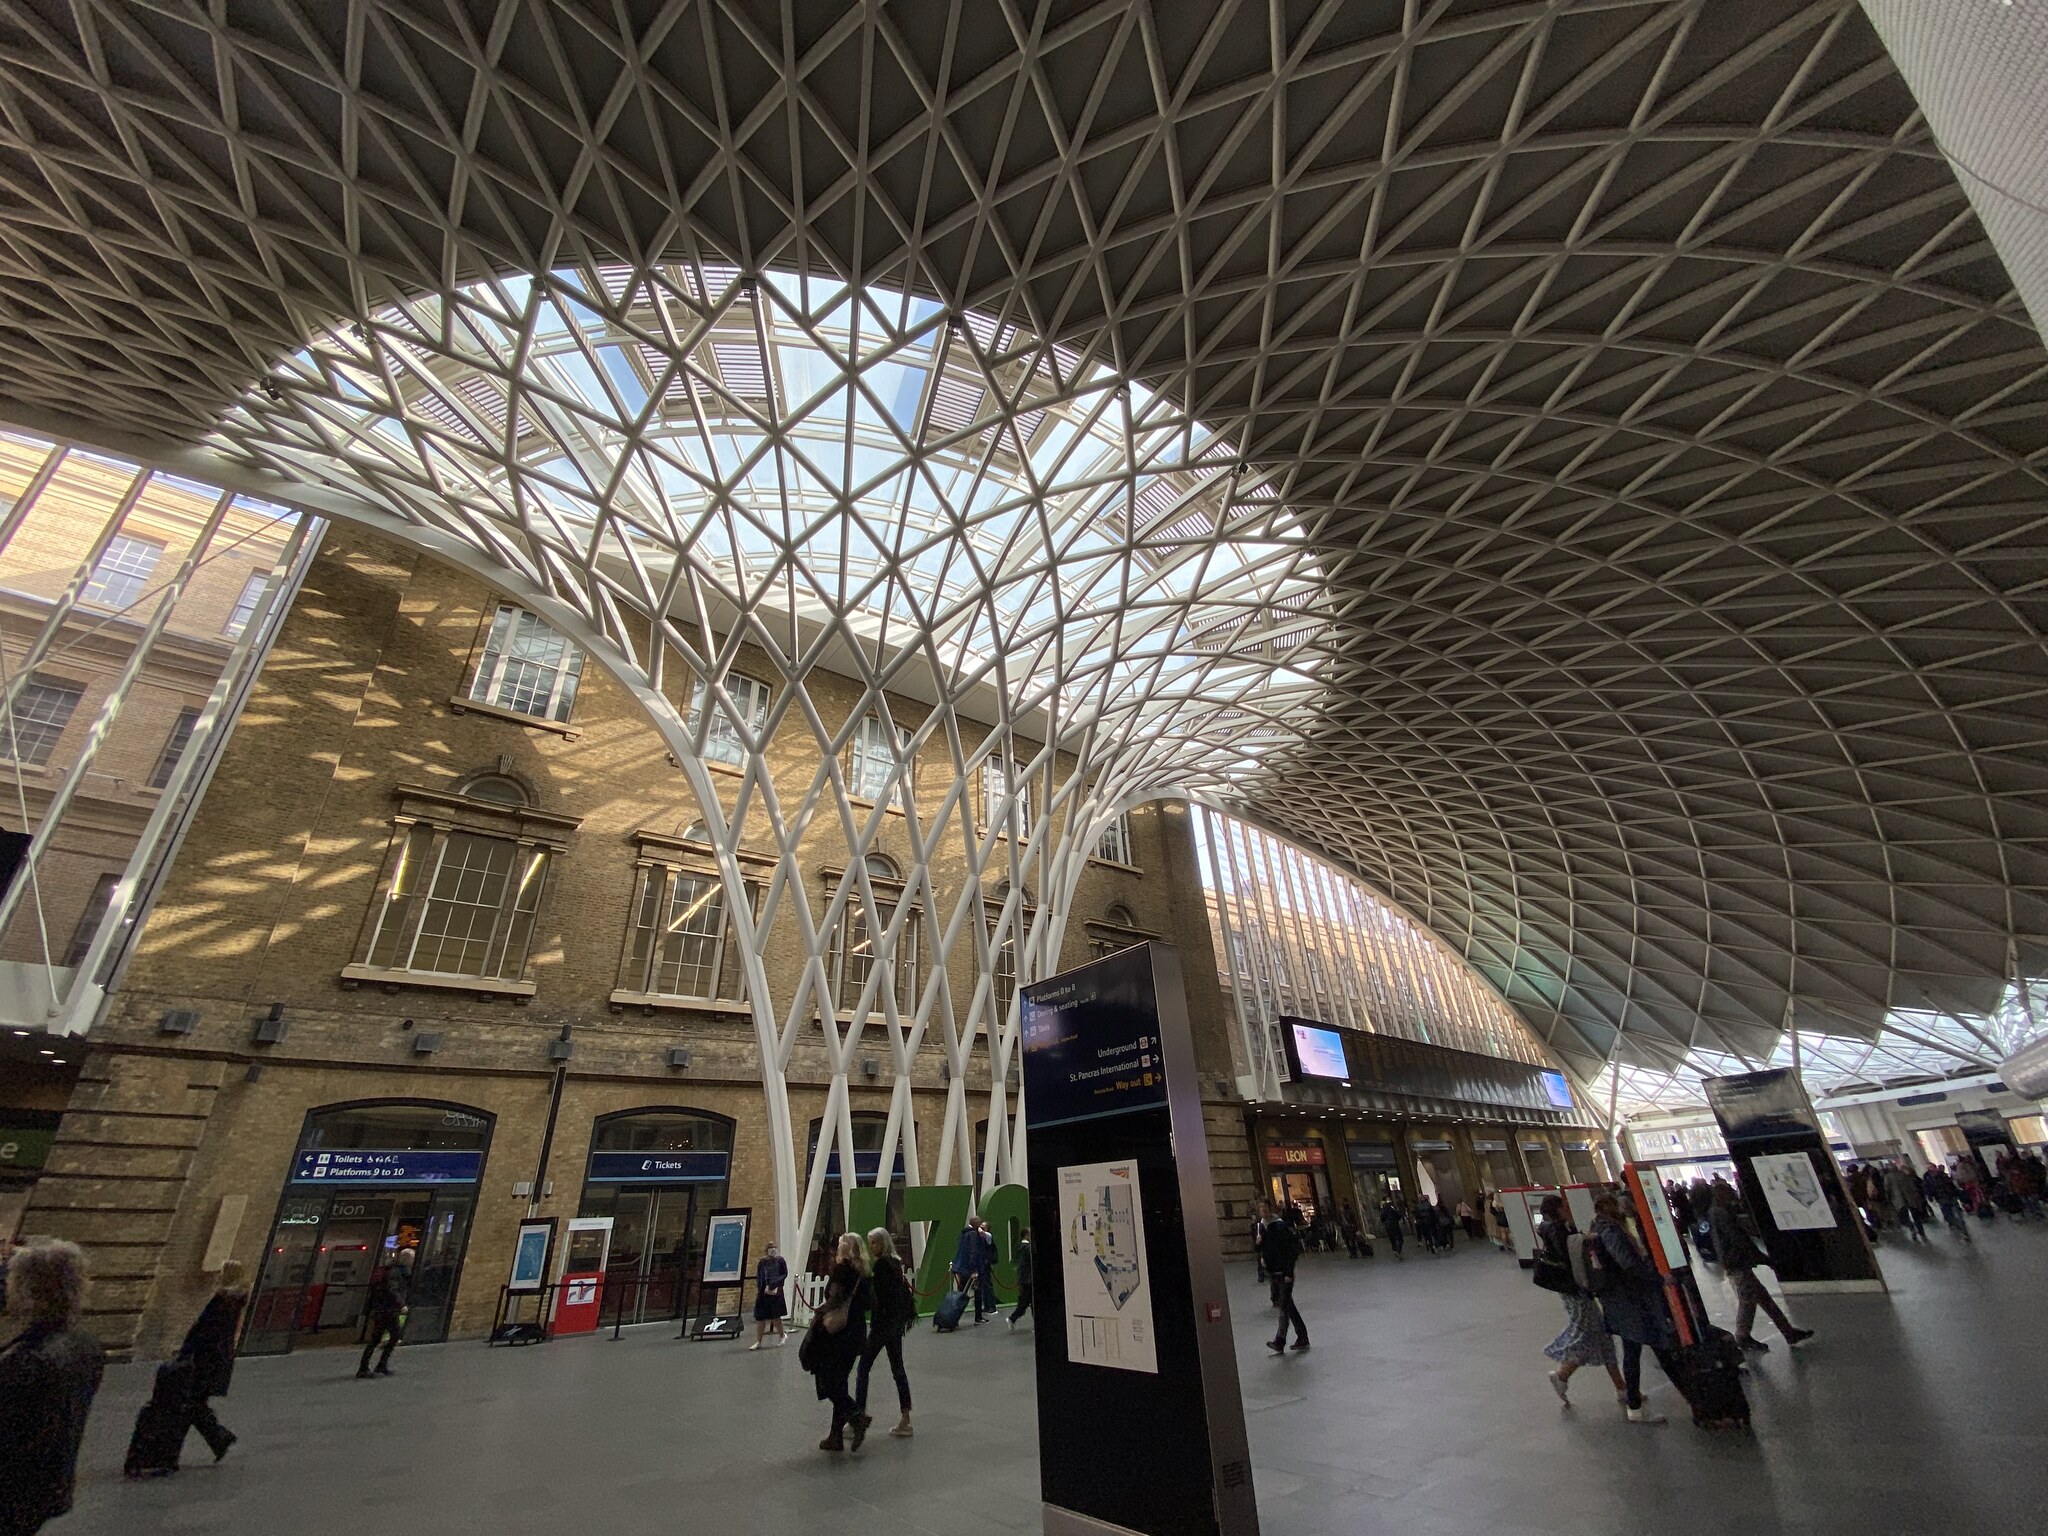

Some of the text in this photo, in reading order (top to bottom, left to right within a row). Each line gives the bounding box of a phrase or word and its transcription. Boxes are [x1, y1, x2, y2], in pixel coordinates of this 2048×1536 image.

[1036, 990, 1060, 1003] Platforms
[1060, 987, 1065, 995] 0
[1071, 983, 1076, 991] 8
[1037, 1006, 1054, 1018] Dining
[1053, 1005, 1059, 1013] &
[1059, 1000, 1078, 1012] seating
[1097, 1041, 1137, 1058] Underground
[1070, 1058, 1139, 1082] St. Pancras International
[1115, 1080, 1129, 1091] Way
[1130, 1079, 1142, 1088] out
[334, 1154, 363, 1163] Toilets
[1285, 1149, 1308, 1162] LEON
[654, 1160, 682, 1169] Tickets
[329, 1167, 405, 1176] Platforms 9 to 10
